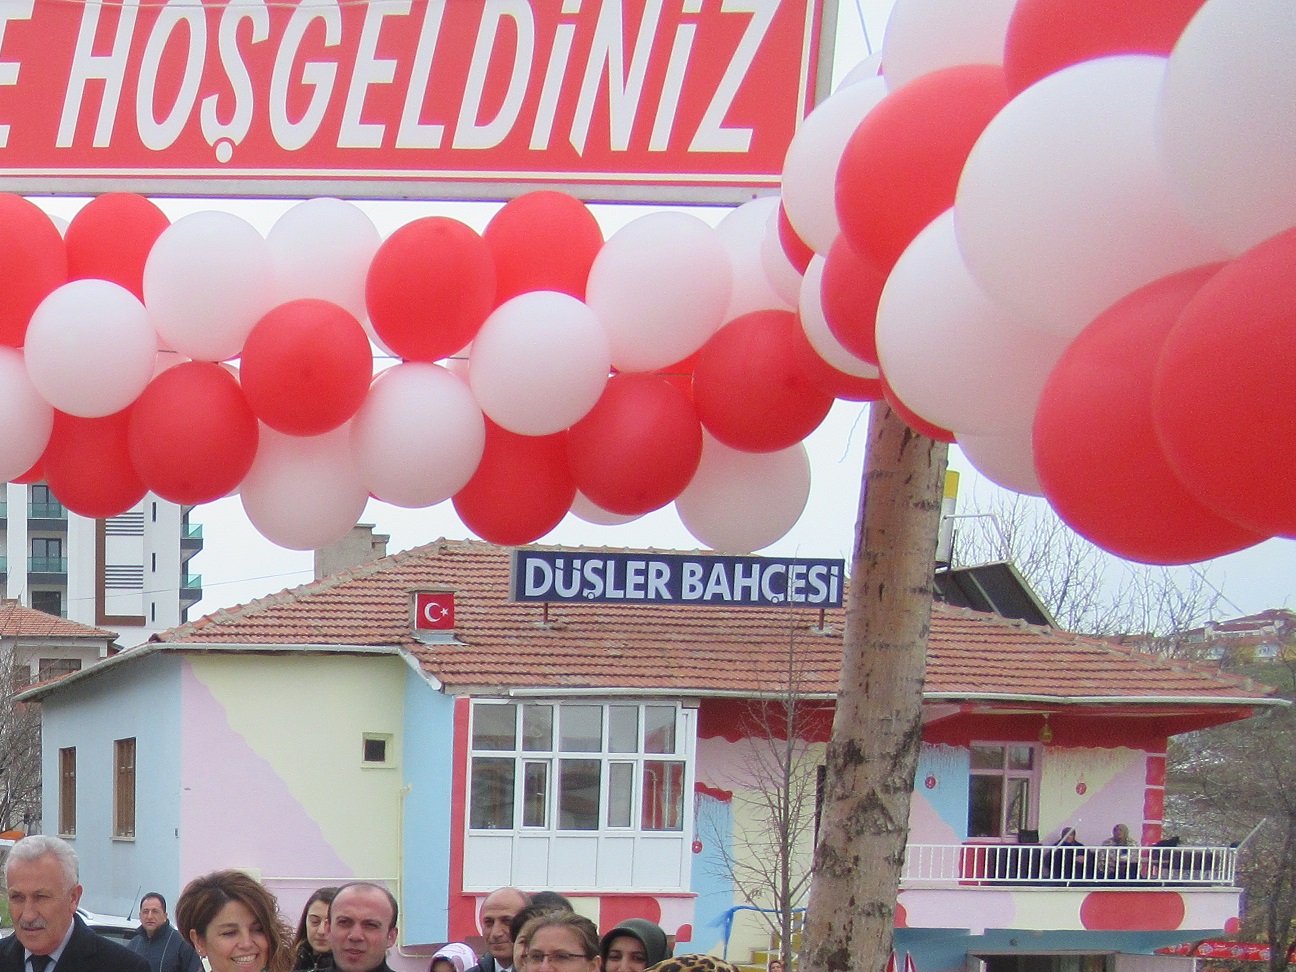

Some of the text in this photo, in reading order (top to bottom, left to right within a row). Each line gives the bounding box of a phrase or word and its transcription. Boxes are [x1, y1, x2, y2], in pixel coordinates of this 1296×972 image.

[55, 0, 780, 163] HOŞGELDİNİZ
[524, 557, 839, 604] DÜŞLER BAHÇESİ
